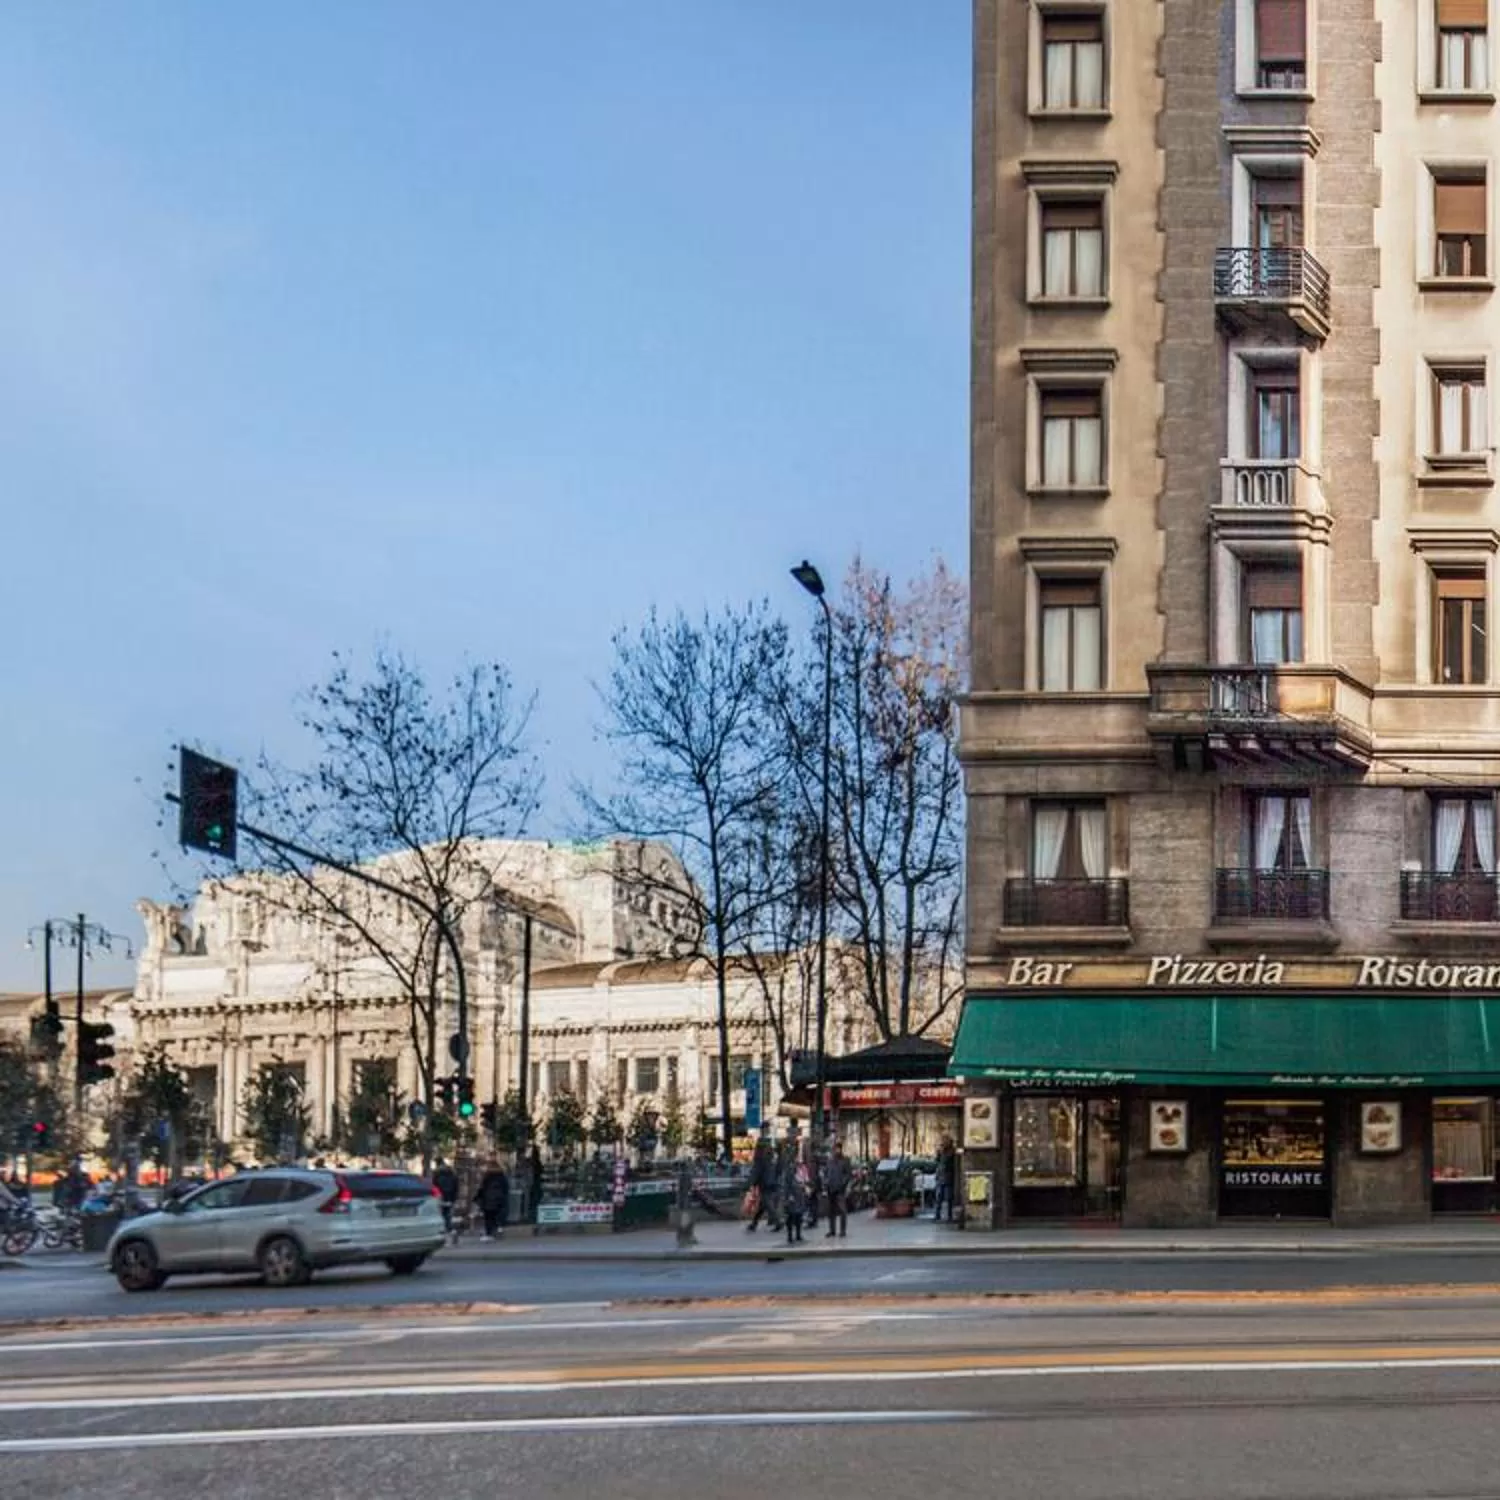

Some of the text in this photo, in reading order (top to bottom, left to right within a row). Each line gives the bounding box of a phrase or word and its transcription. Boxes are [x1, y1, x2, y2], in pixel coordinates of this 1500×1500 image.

[1007, 956, 1073, 986] Bar
[1146, 953, 1285, 986] Pizzeria
[1225, 1171, 1322, 1185] RISTORANTE
